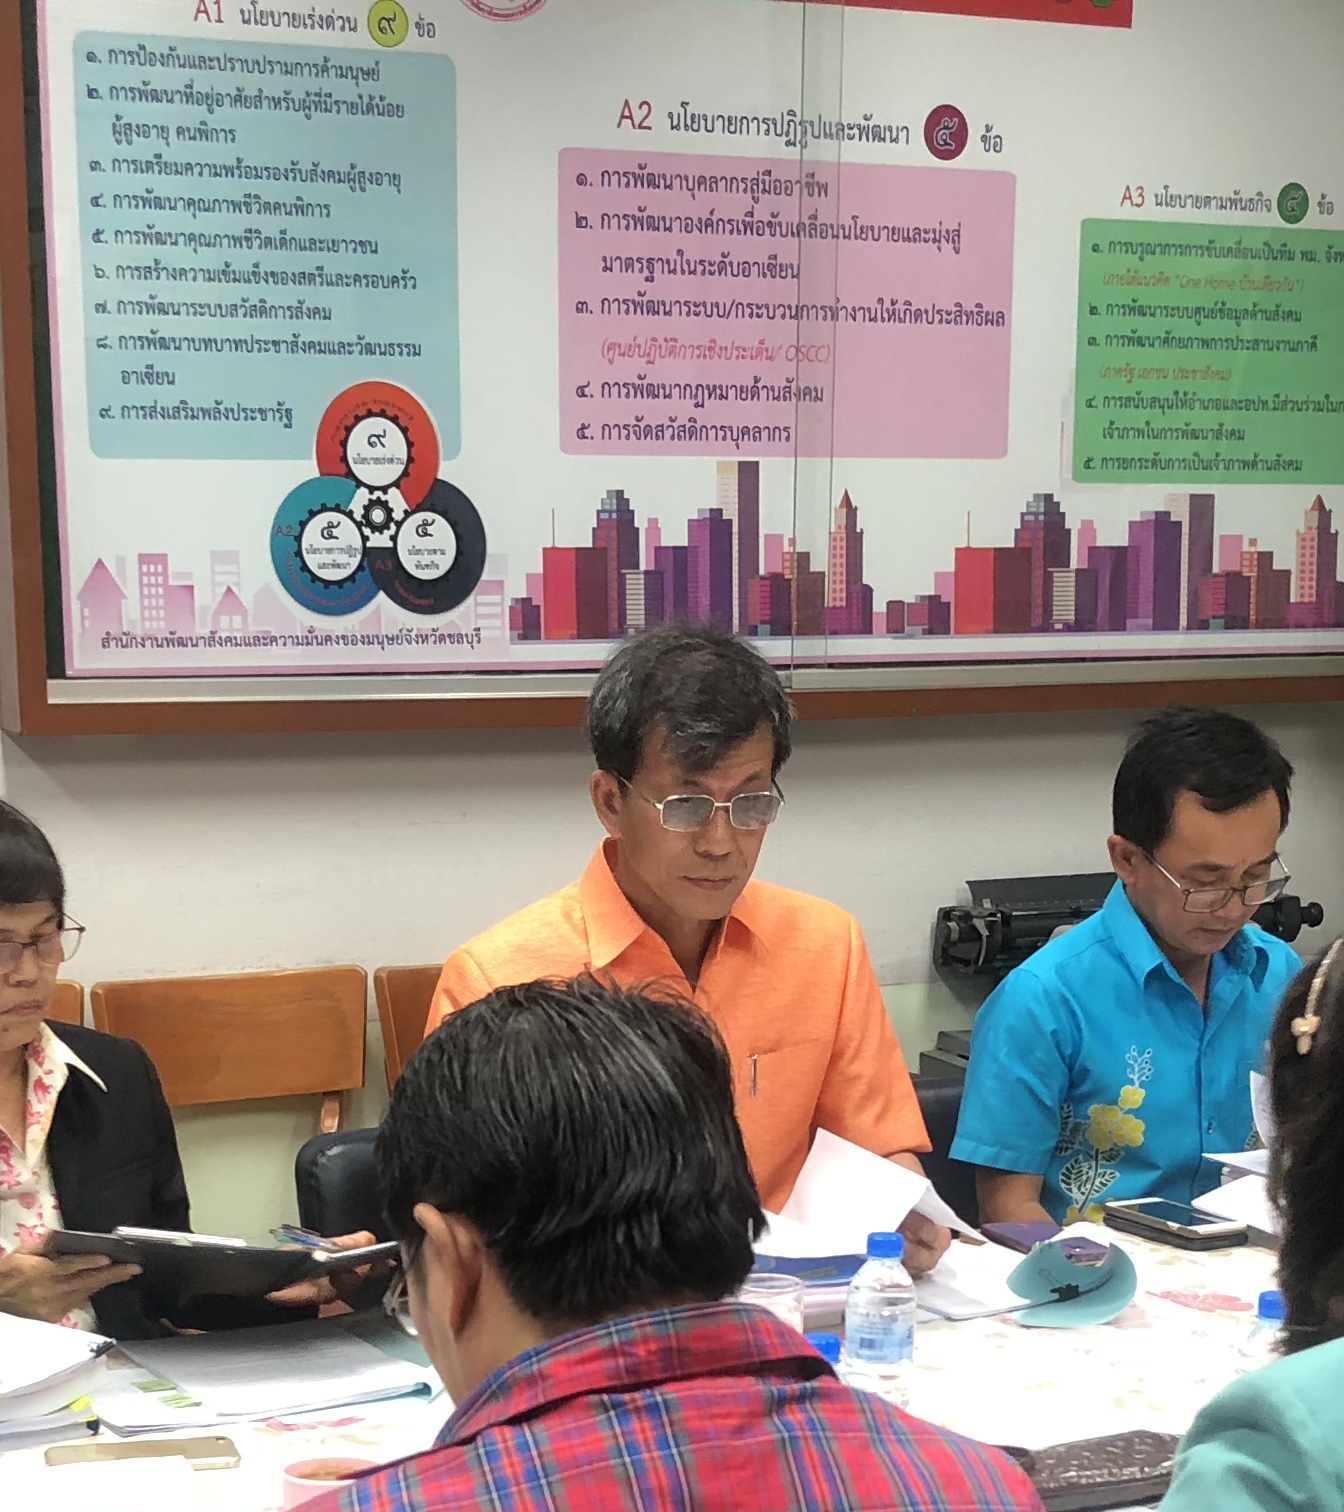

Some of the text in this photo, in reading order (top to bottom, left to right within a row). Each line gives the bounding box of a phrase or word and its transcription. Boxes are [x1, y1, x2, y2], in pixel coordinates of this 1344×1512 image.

[194, 0, 224, 25] A1
[240, 4, 358, 34] นโยบายเร่งด่วน
[414, 17, 436, 39] ข้อ
[107, 45, 381, 84] การป้องกันและปราบปรามการค้ามนุษย์
[111, 114, 236, 146] ผู้สูงอายุ คนพิการ
[616, 100, 653, 132] A2
[668, 102, 910, 149] นโยบายการปฏิรูปและพัฒนา
[980, 128, 1003, 153] ข้อ
[600, 164, 829, 202] การพัฒนาบุคลากรสู่มืออาชีพ
[1120, 185, 1145, 208] A3
[1318, 195, 1334, 215] ข้อ
[602, 250, 801, 282] มาตรฐานในระดับอาเซียน
[120, 365, 176, 386] อาเซียน
[601, 417, 791, 449] การจัดสวัสดิการบุคลากร
